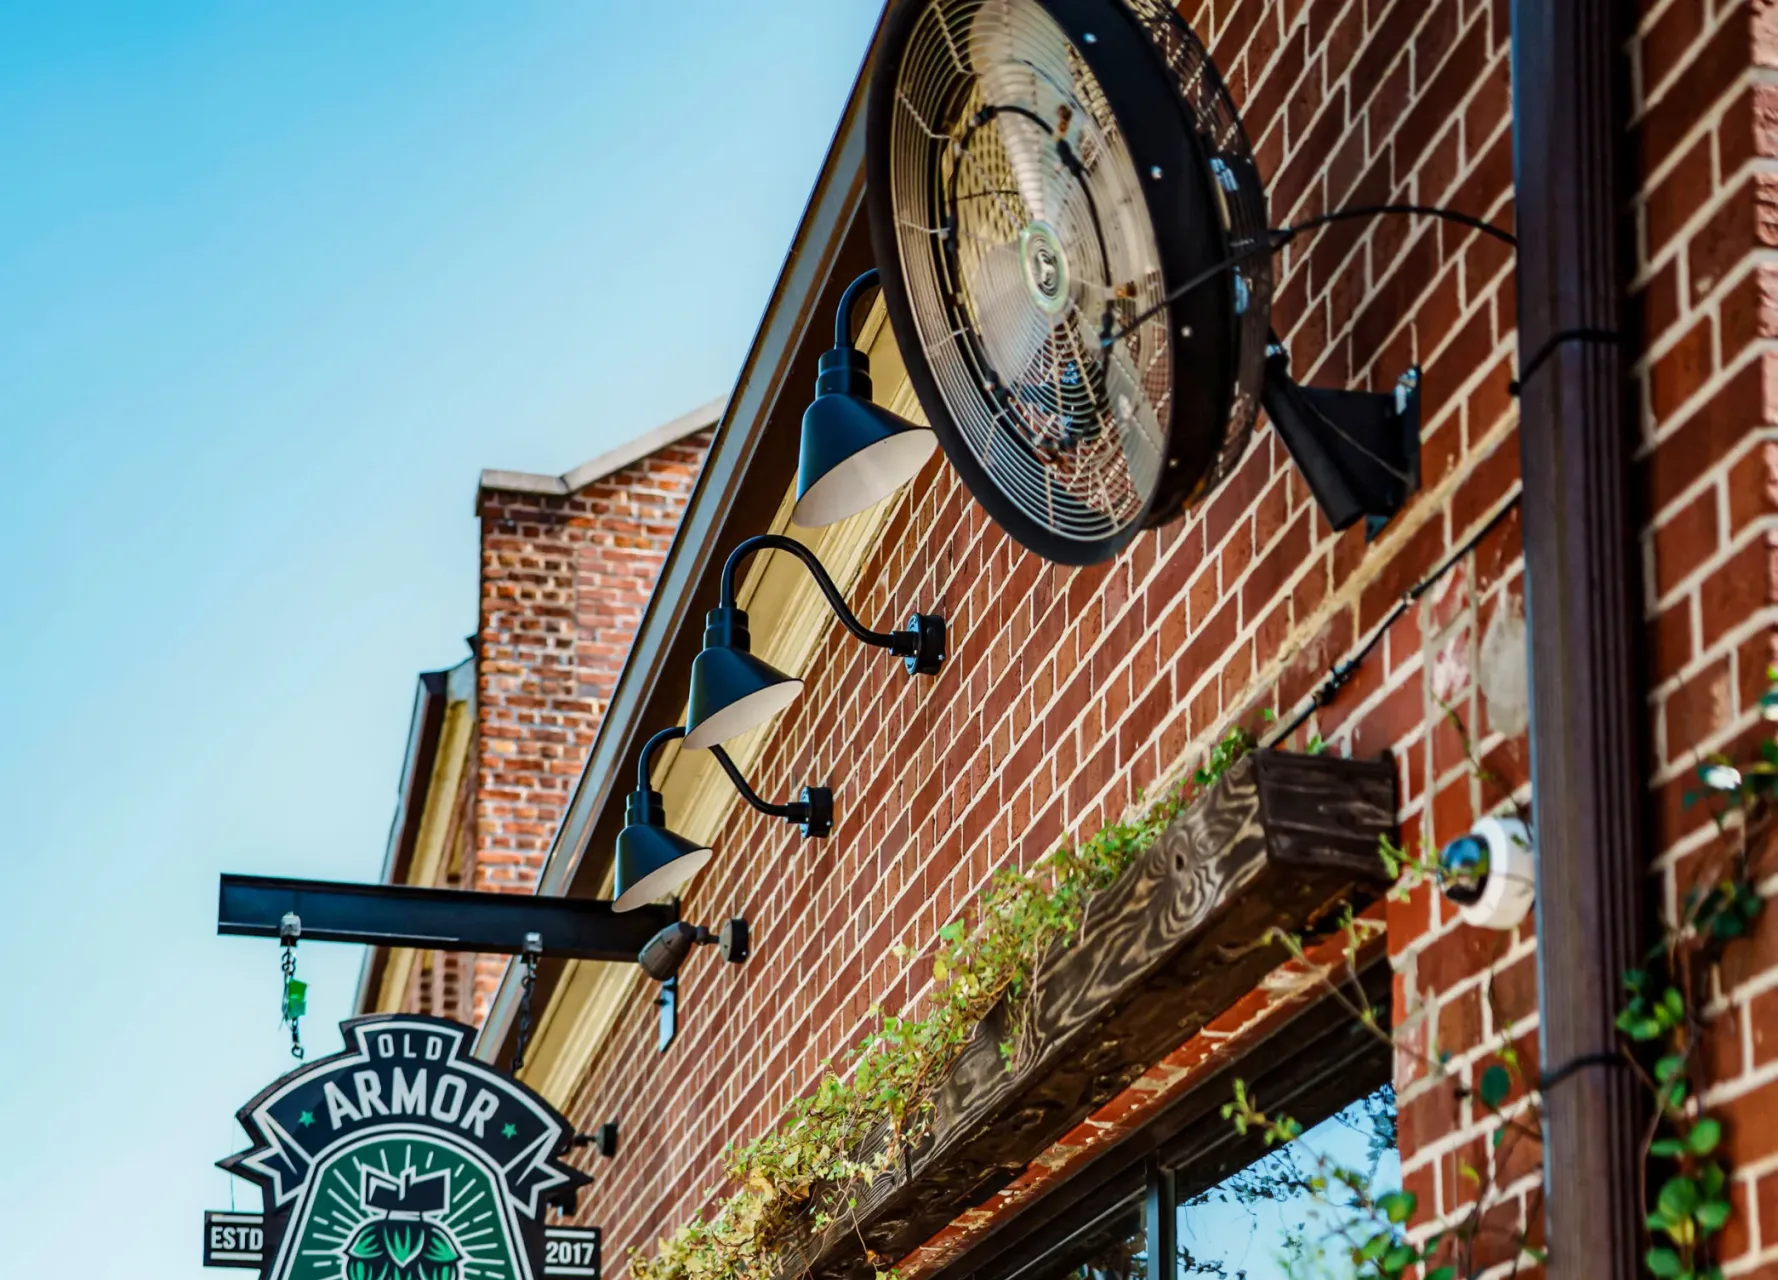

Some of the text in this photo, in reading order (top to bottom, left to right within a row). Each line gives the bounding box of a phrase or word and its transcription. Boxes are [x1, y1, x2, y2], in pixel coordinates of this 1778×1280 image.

[377, 1033, 443, 1061] OLD
[323, 1066, 500, 1139] ARMOR
[211, 1226, 264, 1250] ESTD
[545, 1240, 595, 1265] 2017
